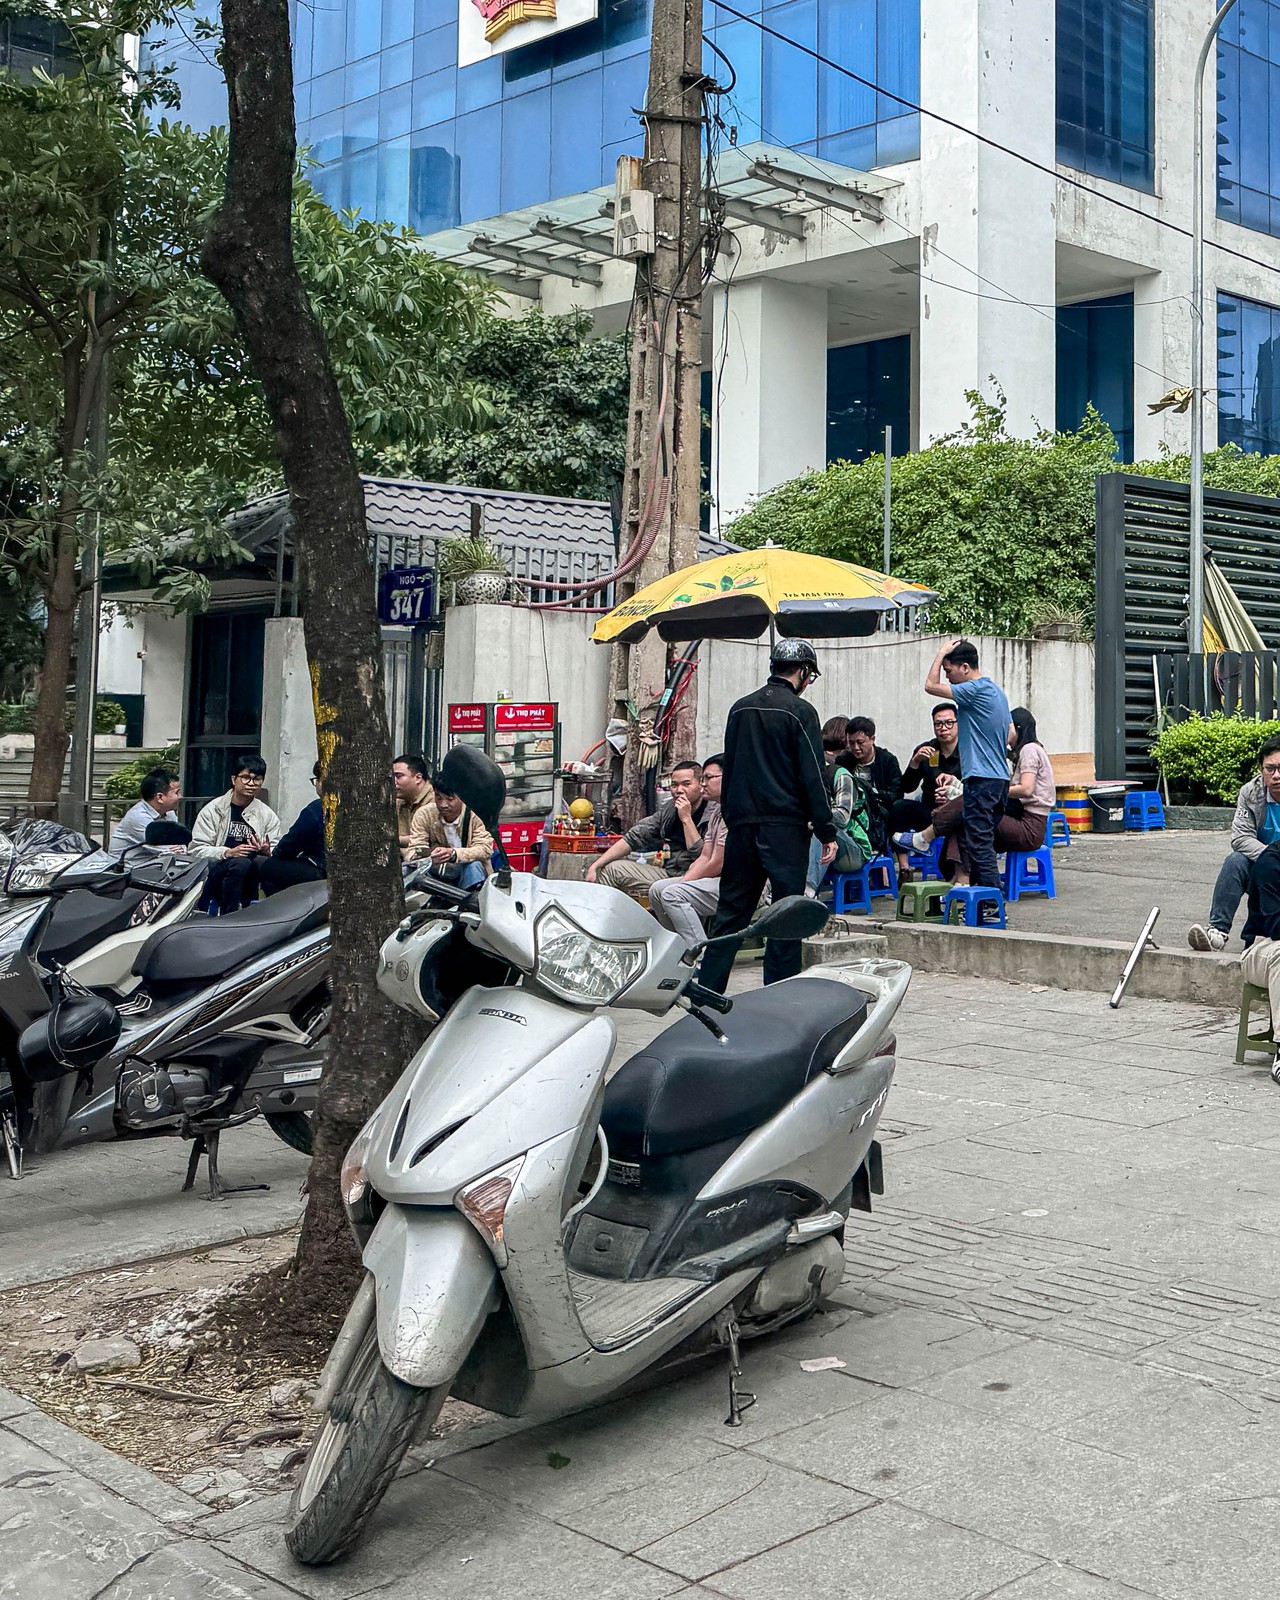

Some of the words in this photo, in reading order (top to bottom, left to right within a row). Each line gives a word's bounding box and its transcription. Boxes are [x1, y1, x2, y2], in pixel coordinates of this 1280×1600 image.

[390, 587, 425, 620] 347
[529, 708, 546, 717] PHÁT
[478, 1008, 527, 1026] HONDA
